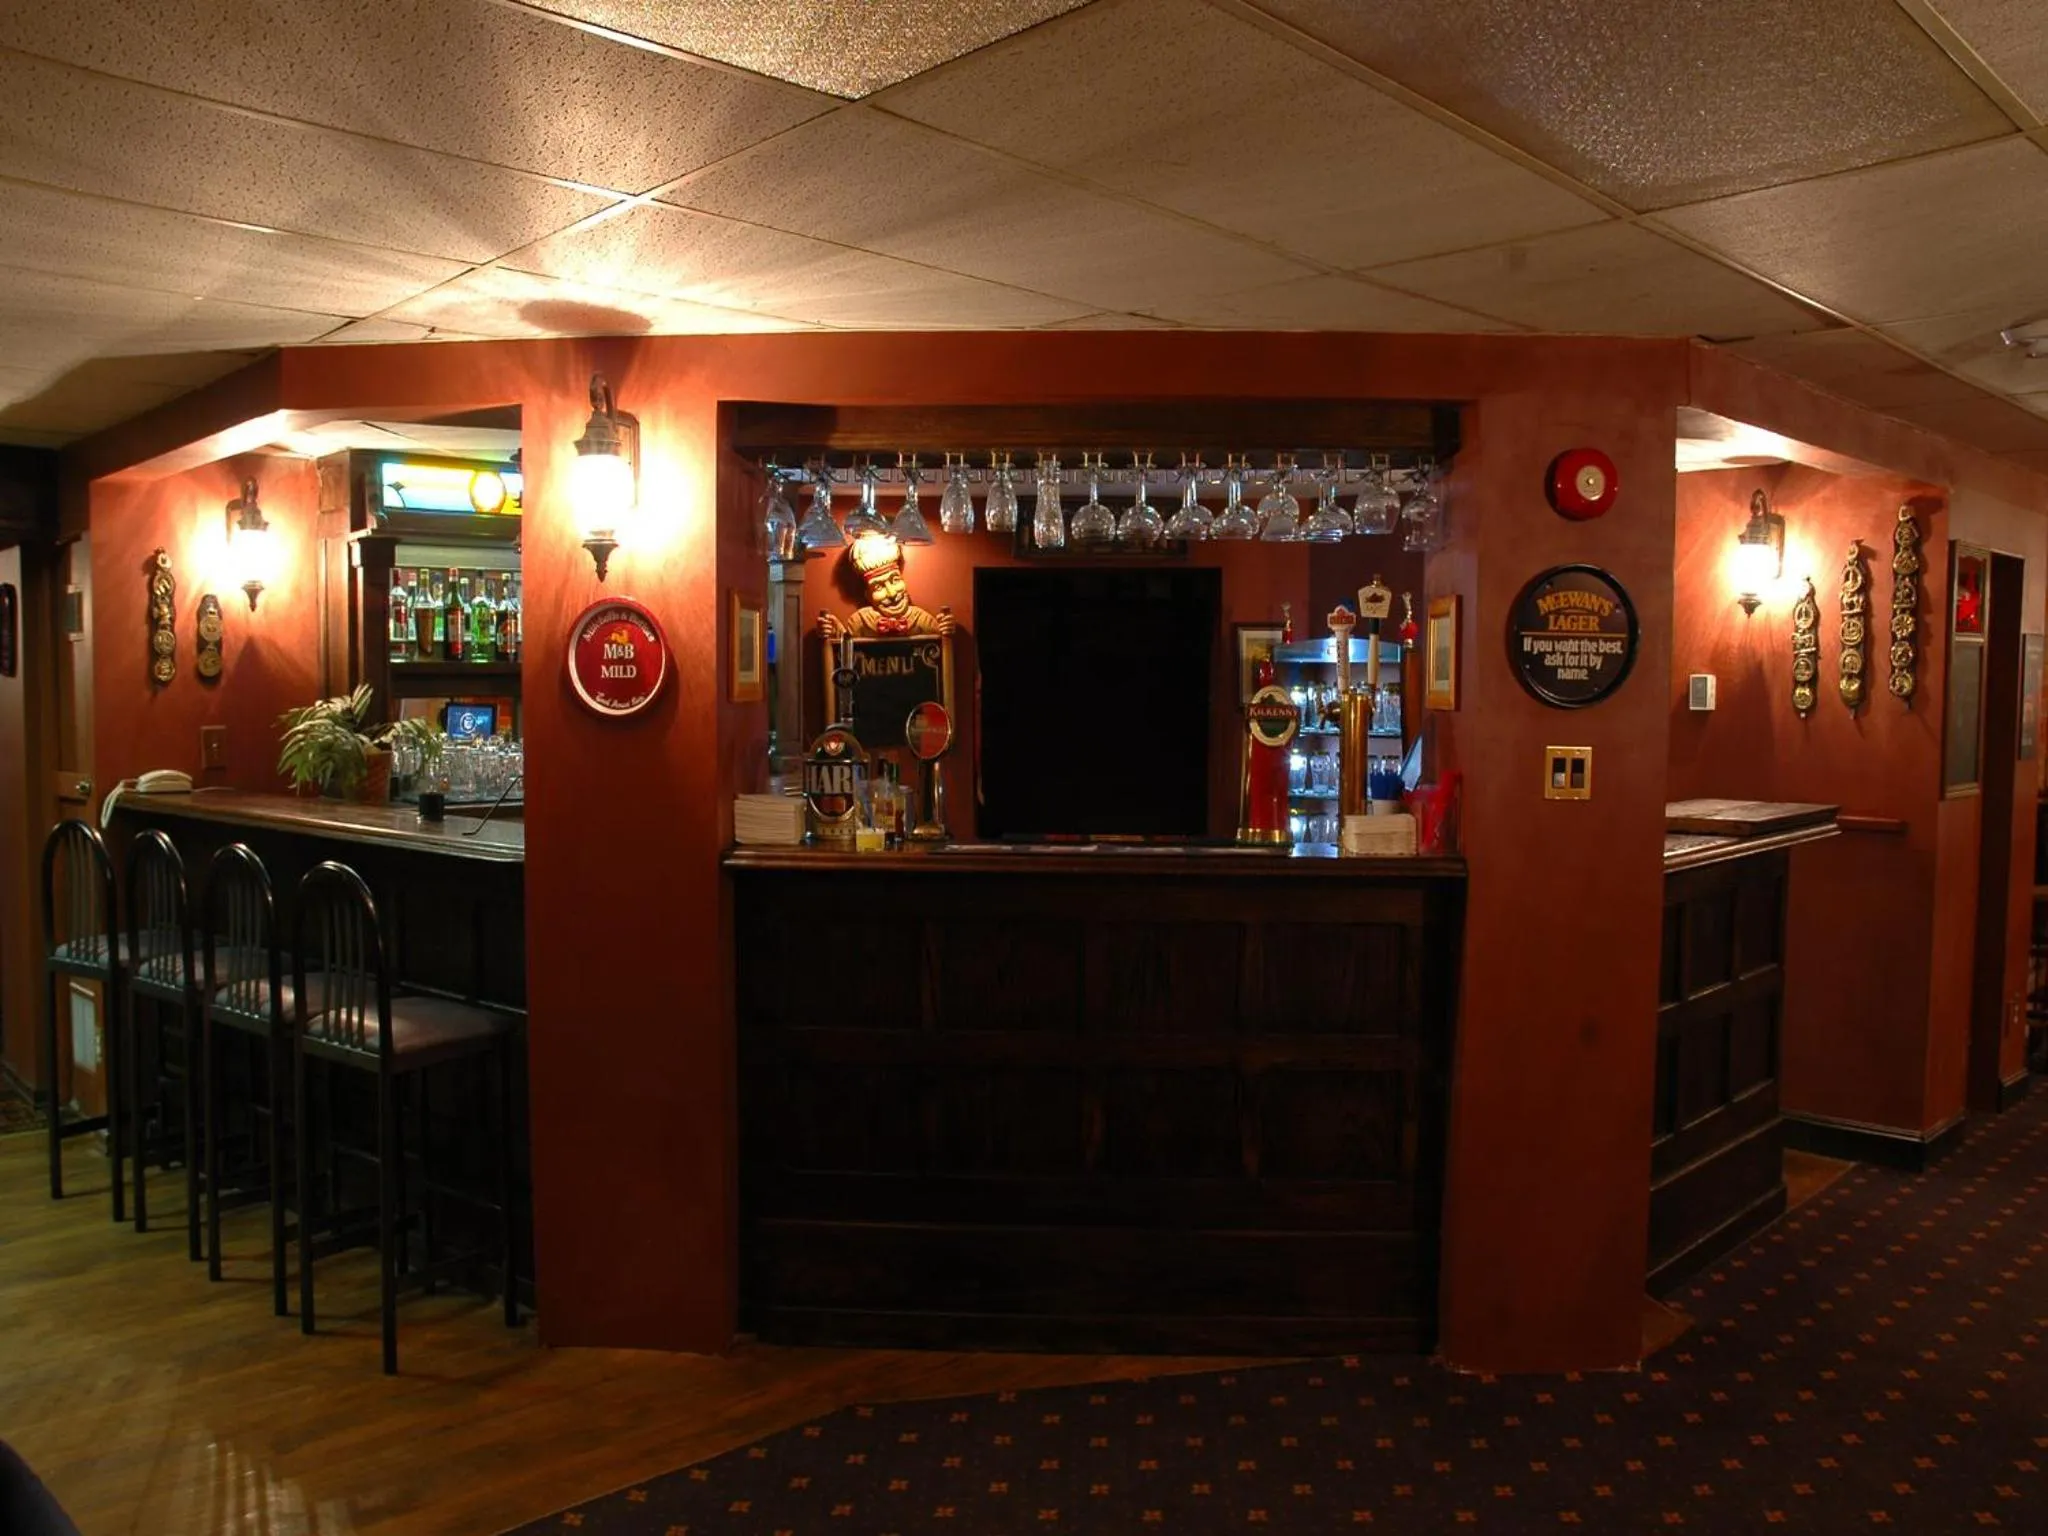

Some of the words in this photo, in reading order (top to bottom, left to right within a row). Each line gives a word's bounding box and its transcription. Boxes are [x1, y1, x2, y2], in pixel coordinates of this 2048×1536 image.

[1548, 614, 1600, 631] LAGER
[603, 643, 634, 659] M&B
[1523, 637, 1532, 651] If
[1532, 640, 1552, 655] you
[1554, 639, 1578, 652] want
[1580, 639, 1597, 652] the
[861, 655, 915, 675] MENU
[1543, 653, 1563, 666] ask
[1564, 653, 1580, 667] for
[1580, 653, 1588, 666] it
[1589, 654, 1603, 670] by
[600, 664, 637, 678] MILD
